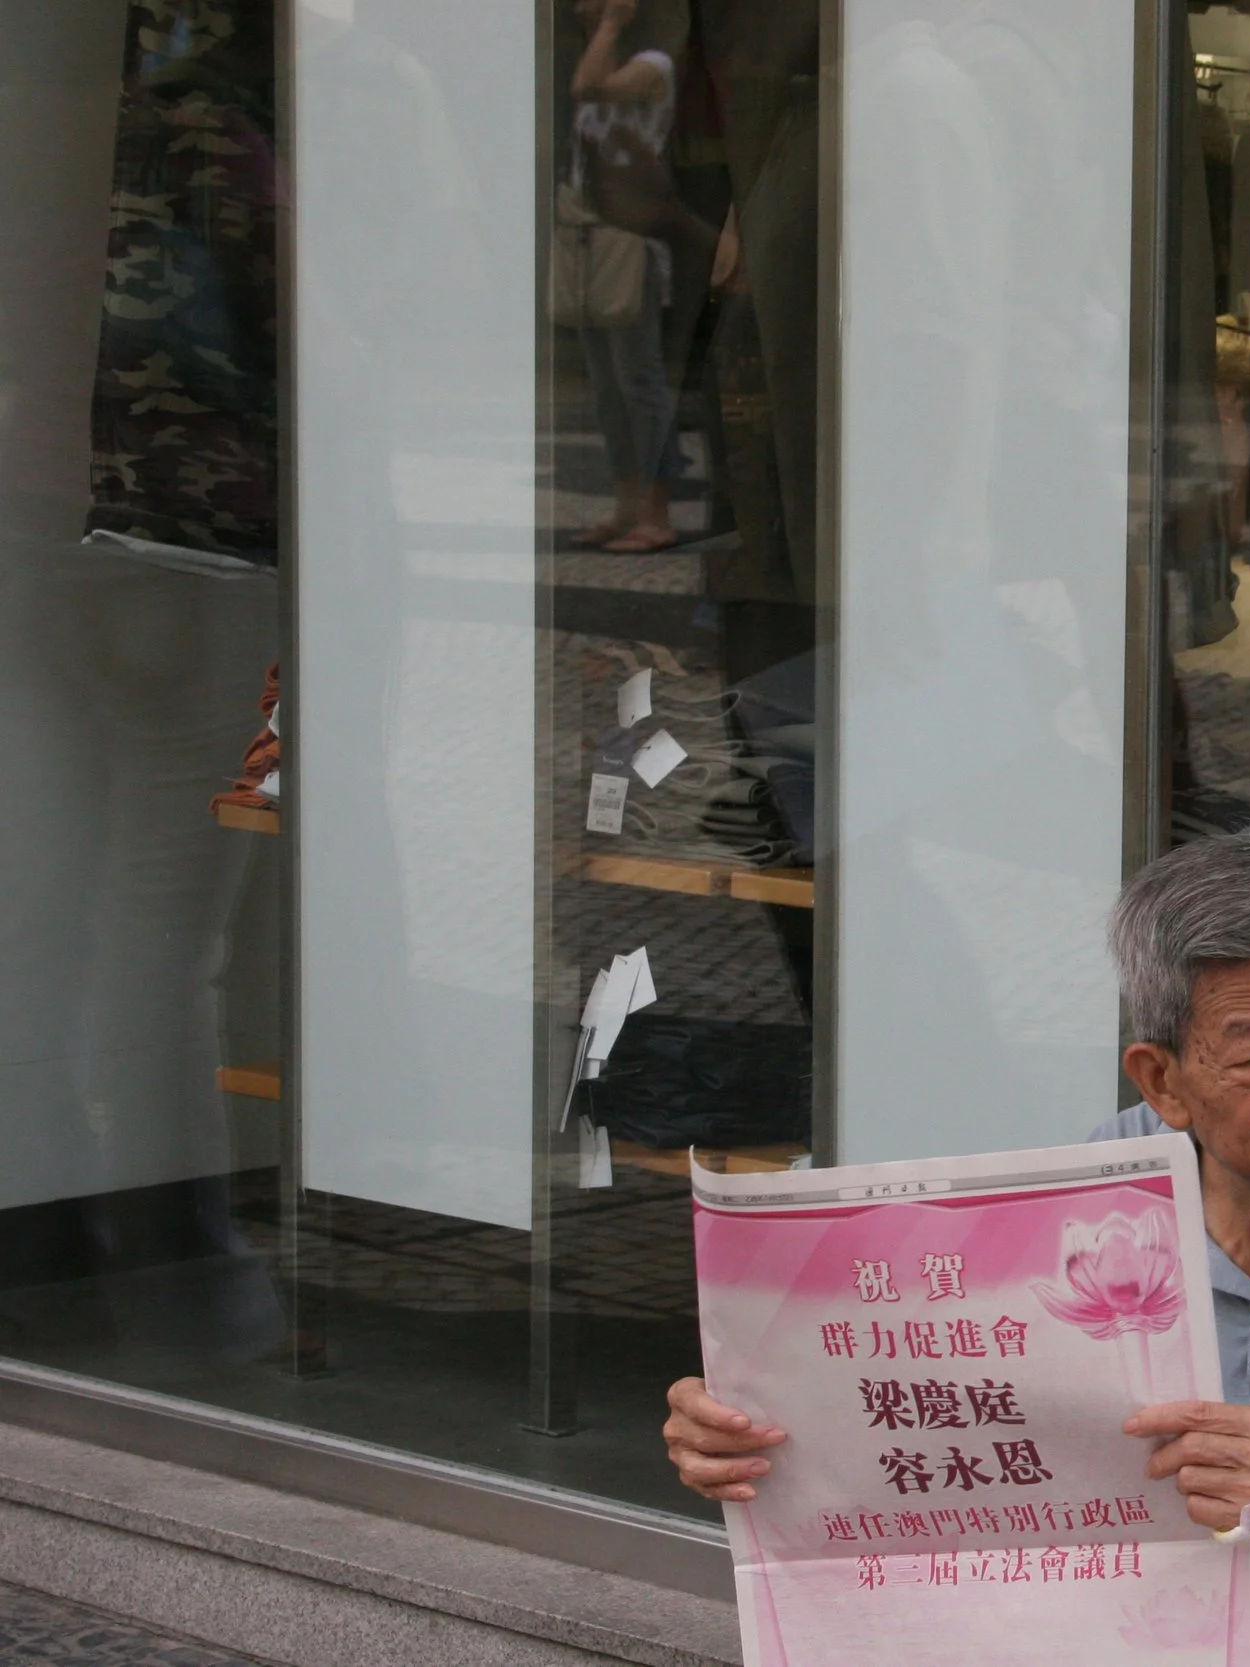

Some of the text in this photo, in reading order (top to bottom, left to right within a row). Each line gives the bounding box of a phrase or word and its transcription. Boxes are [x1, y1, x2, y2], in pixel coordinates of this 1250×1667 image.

[851, 1252, 966, 1304] 祝賀
[818, 1314, 1029, 1360] 群力促進會
[857, 1376, 1027, 1431] 梁慶庭
[878, 1438, 1054, 1495] 容永恩
[821, 1493, 1155, 1541] 連任澳門特別行政區
[856, 1540, 1143, 1591] 第三屆立法會議員
